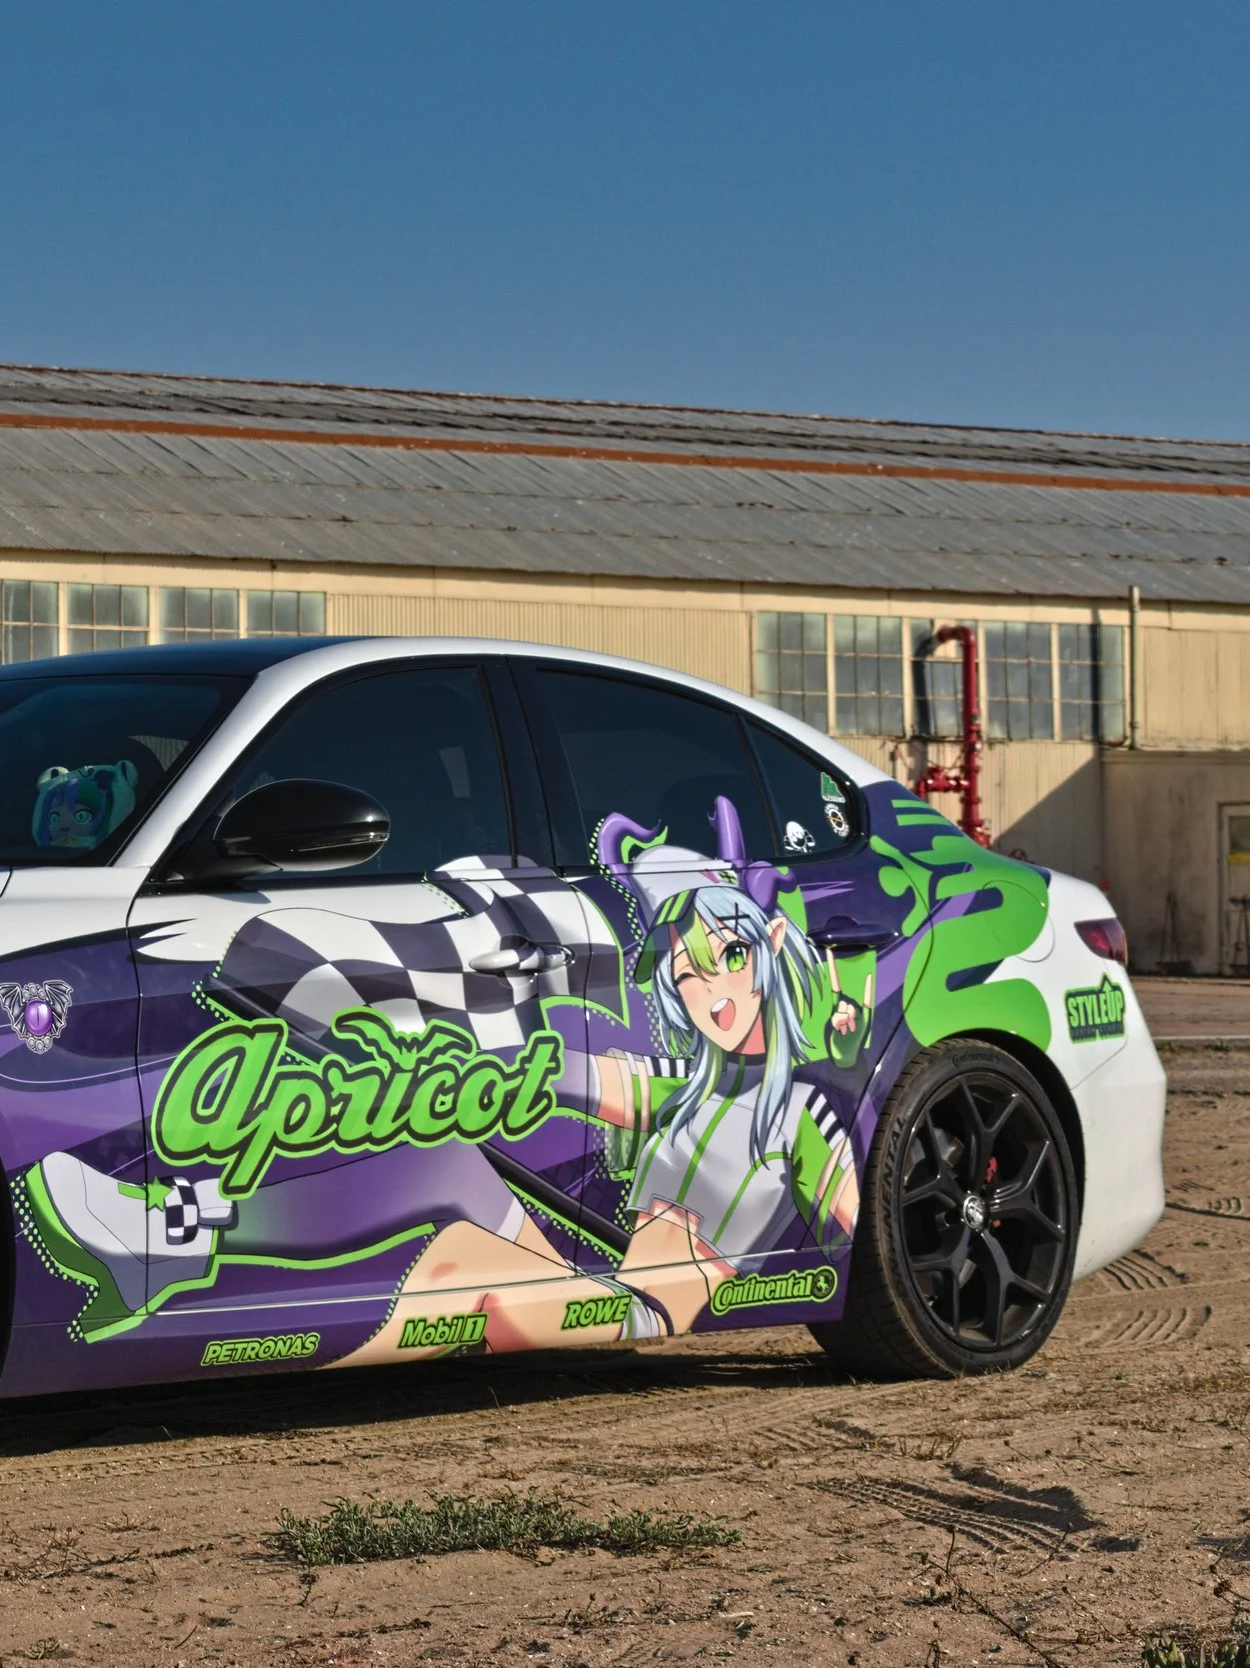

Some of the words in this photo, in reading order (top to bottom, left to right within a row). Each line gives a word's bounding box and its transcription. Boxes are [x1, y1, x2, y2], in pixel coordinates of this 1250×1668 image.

[156, 1020, 563, 1196] Apricot
[712, 1271, 814, 1315] Continental
[398, 1315, 459, 1348] Mobil
[461, 1313, 488, 1342] 1
[561, 1294, 633, 1331] ROWE
[201, 1333, 319, 1366] PETRONAS
